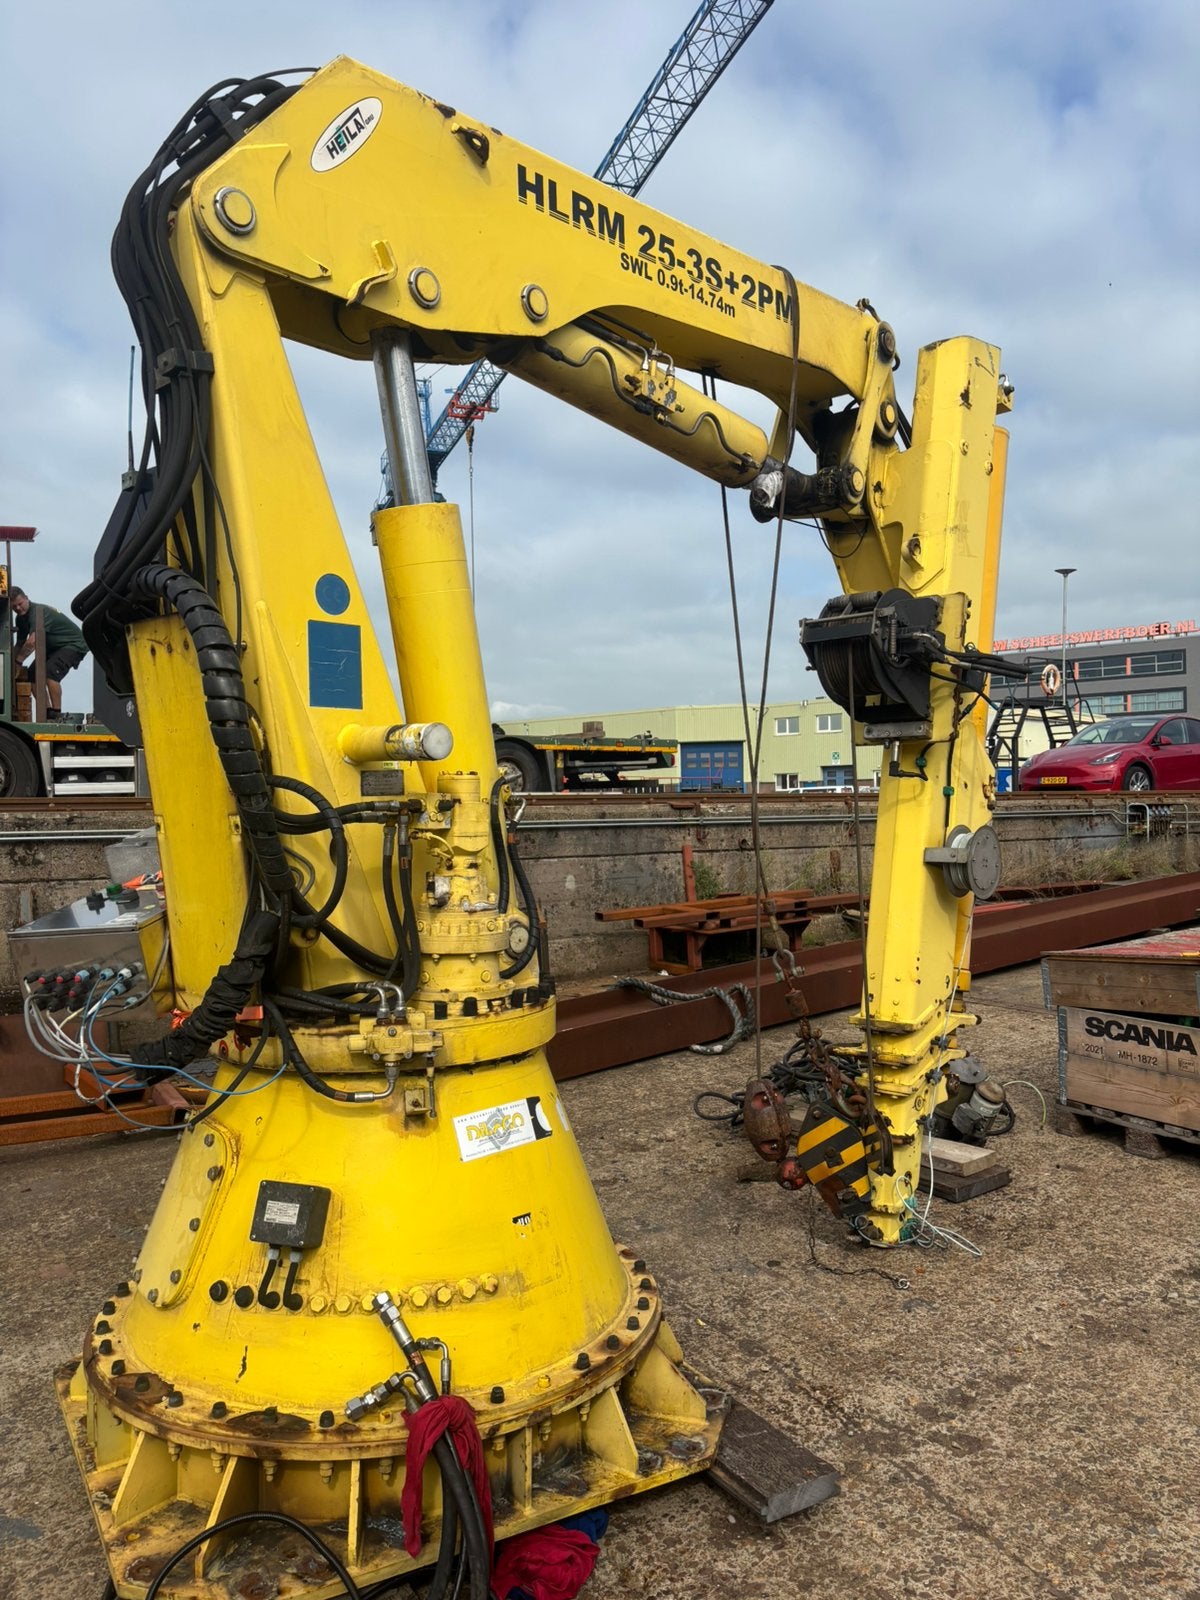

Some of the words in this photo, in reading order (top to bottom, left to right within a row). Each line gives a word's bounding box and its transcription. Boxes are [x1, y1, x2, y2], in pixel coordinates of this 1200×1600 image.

[326, 117, 365, 160] HEILA
[517, 163, 625, 250] HLRM
[637, 224, 794, 326] 25-3S+2PM
[620, 252, 653, 282] SWL
[657, 268, 736, 318] 0.9t-14.74m
[1085, 1016, 1198, 1056] SCANIA
[1085, 1043, 1104, 1055] 2021
[1118, 1050, 1158, 1066] MH-1872
